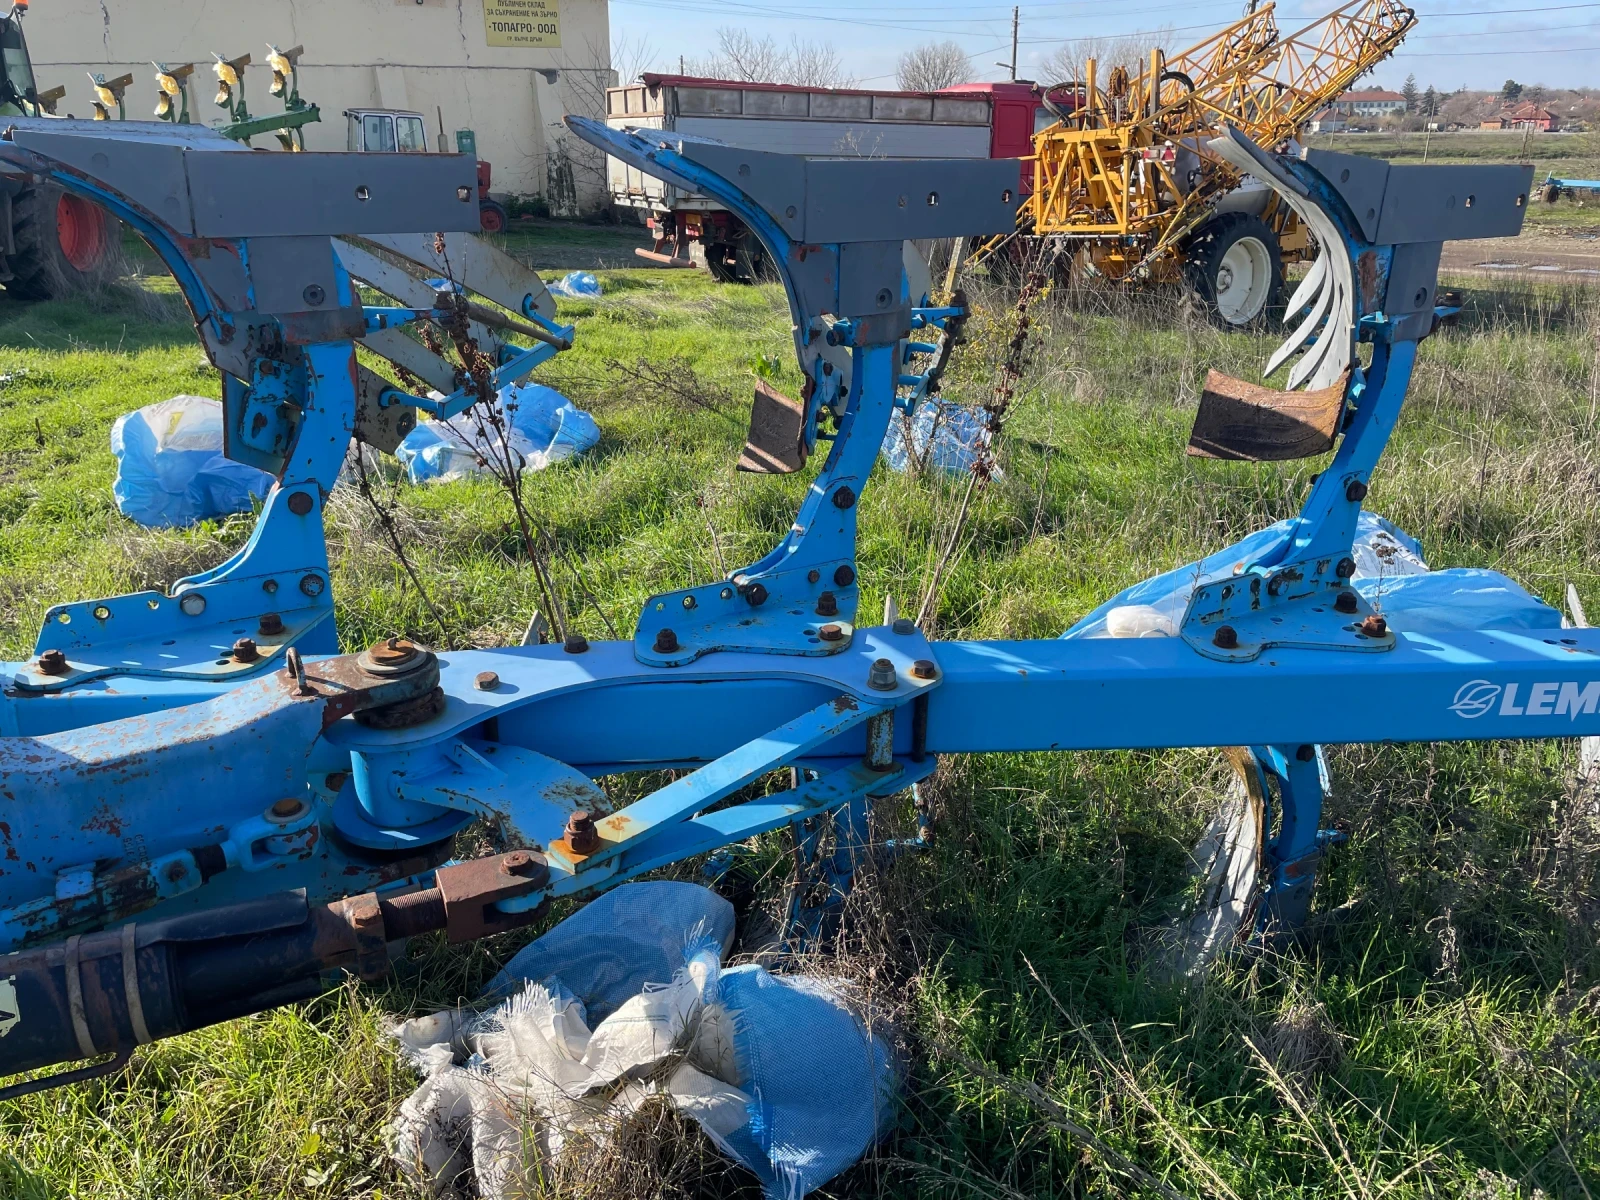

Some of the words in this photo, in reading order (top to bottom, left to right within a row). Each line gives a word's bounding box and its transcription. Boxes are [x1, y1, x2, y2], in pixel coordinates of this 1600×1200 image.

[497, 0, 526, 8] ПУБЛИЧЕН
[527, 1, 545, 9] СКЛАД
[495, 9, 530, 17] СЪХРАНЕНИЕ
[538, 24, 557, 35] ООД
[1499, 681, 1600, 722] LEM
